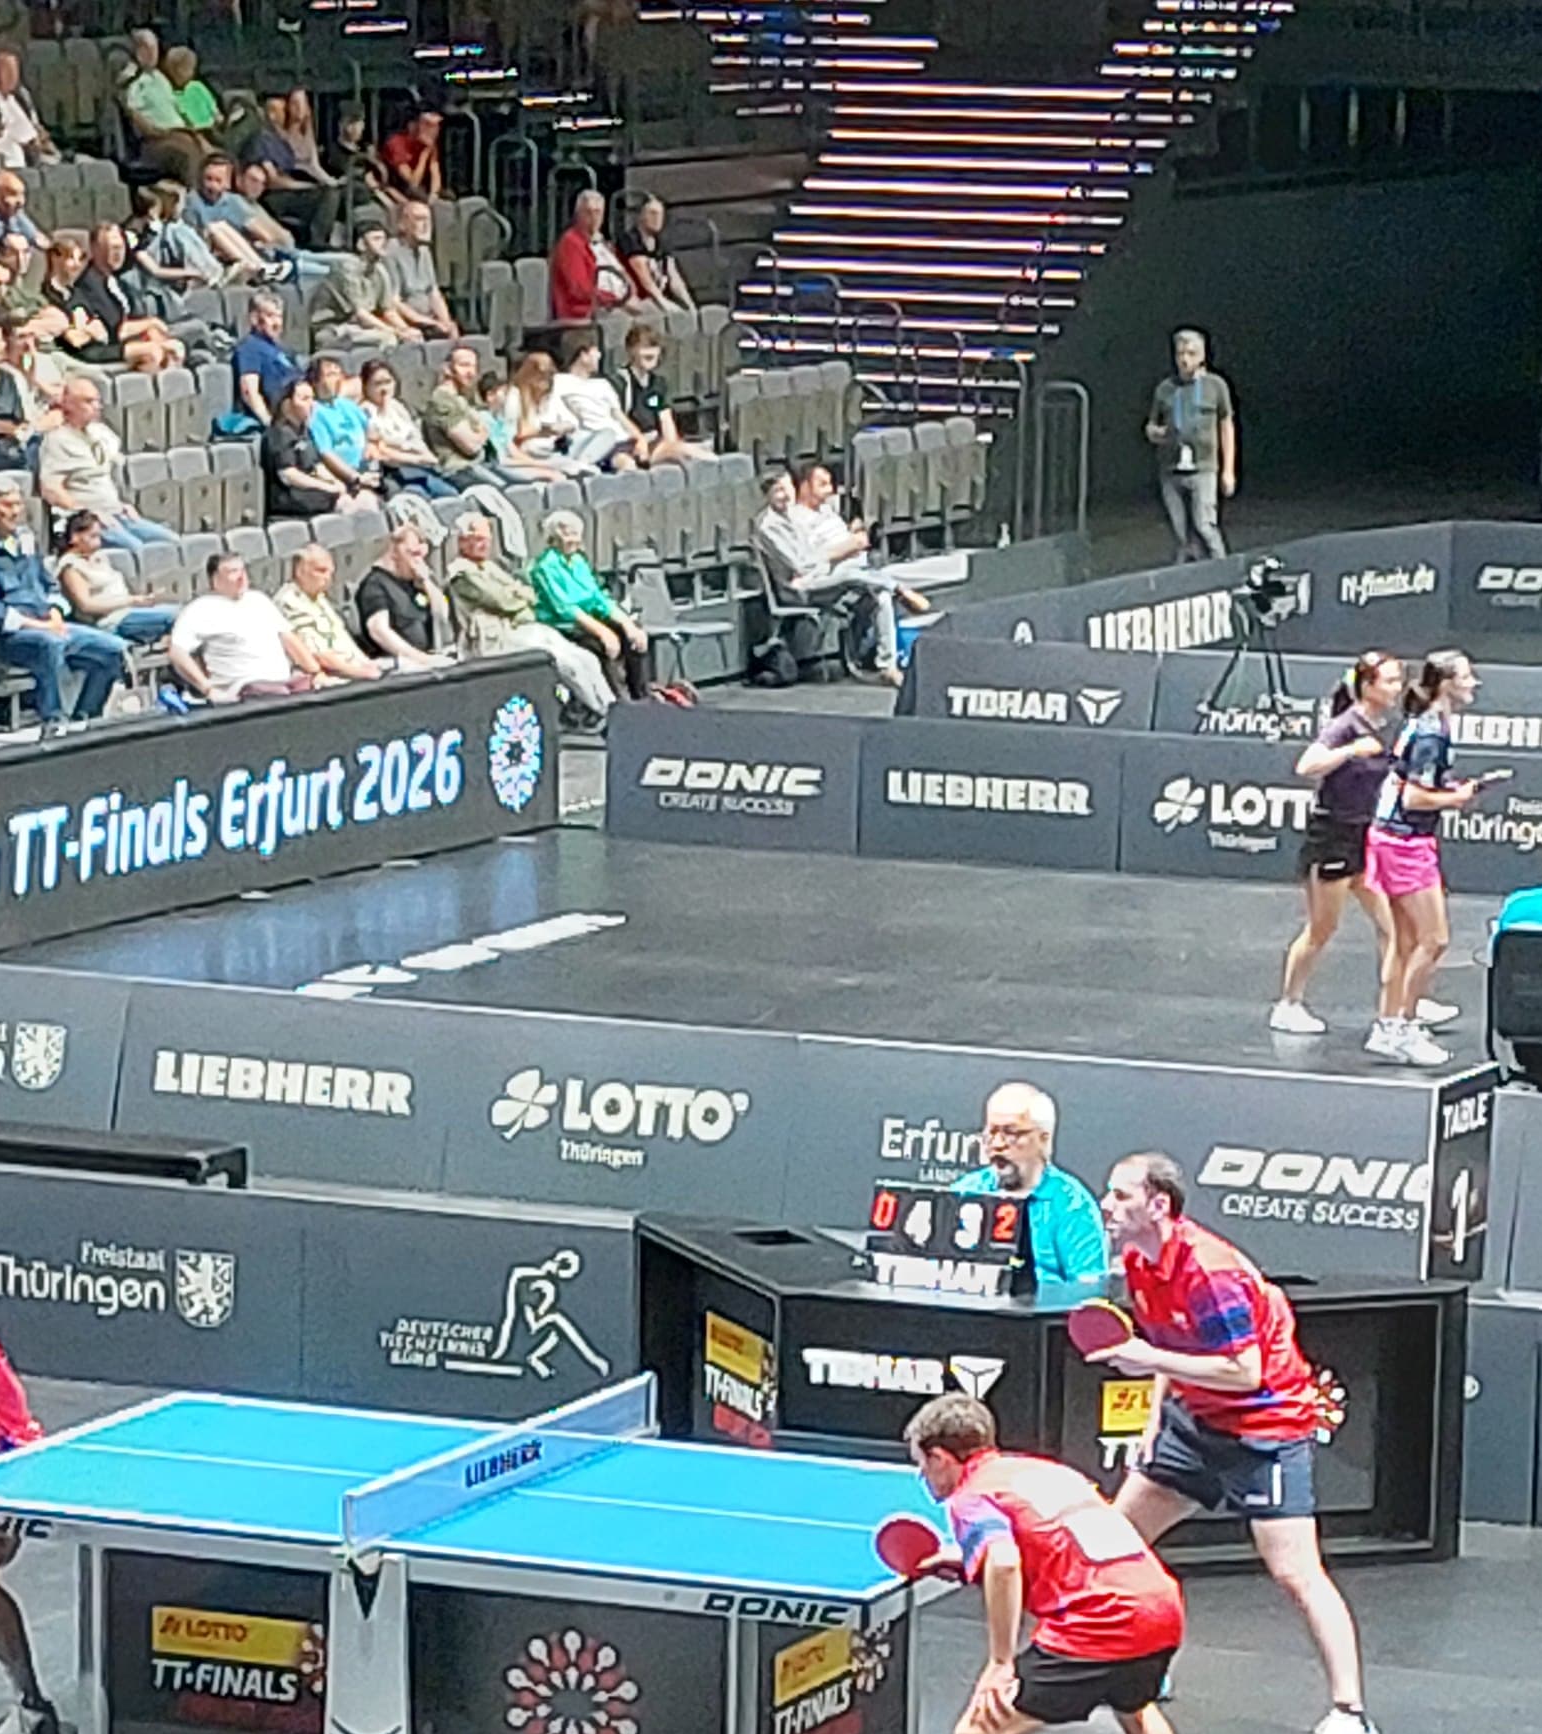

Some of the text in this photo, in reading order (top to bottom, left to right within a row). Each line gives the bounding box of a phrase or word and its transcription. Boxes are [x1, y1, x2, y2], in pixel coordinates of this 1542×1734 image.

[641, 757, 823, 797] DONIC
[887, 769, 1094, 818] LIEBHERR
[8, 778, 210, 898] TT-Finals
[221, 757, 346, 857] Erfurt
[354, 728, 463, 823] 2026
[1209, 784, 1313, 831] LOTT
[154, 1050, 414, 1118] LIEBHERR
[562, 1078, 734, 1142] LOTTO
[1443, 1092, 1490, 1139] TABLE
[880, 1117, 988, 1166] Erfur
[872, 1190, 897, 1231] 0
[904, 1198, 934, 1248] 4
[992, 1203, 1019, 1242] 2
[1221, 1193, 1420, 1231] CREATE SUCCESS
[81, 1241, 165, 1271] Freistaat
[704, 1592, 850, 1626] DONIC
